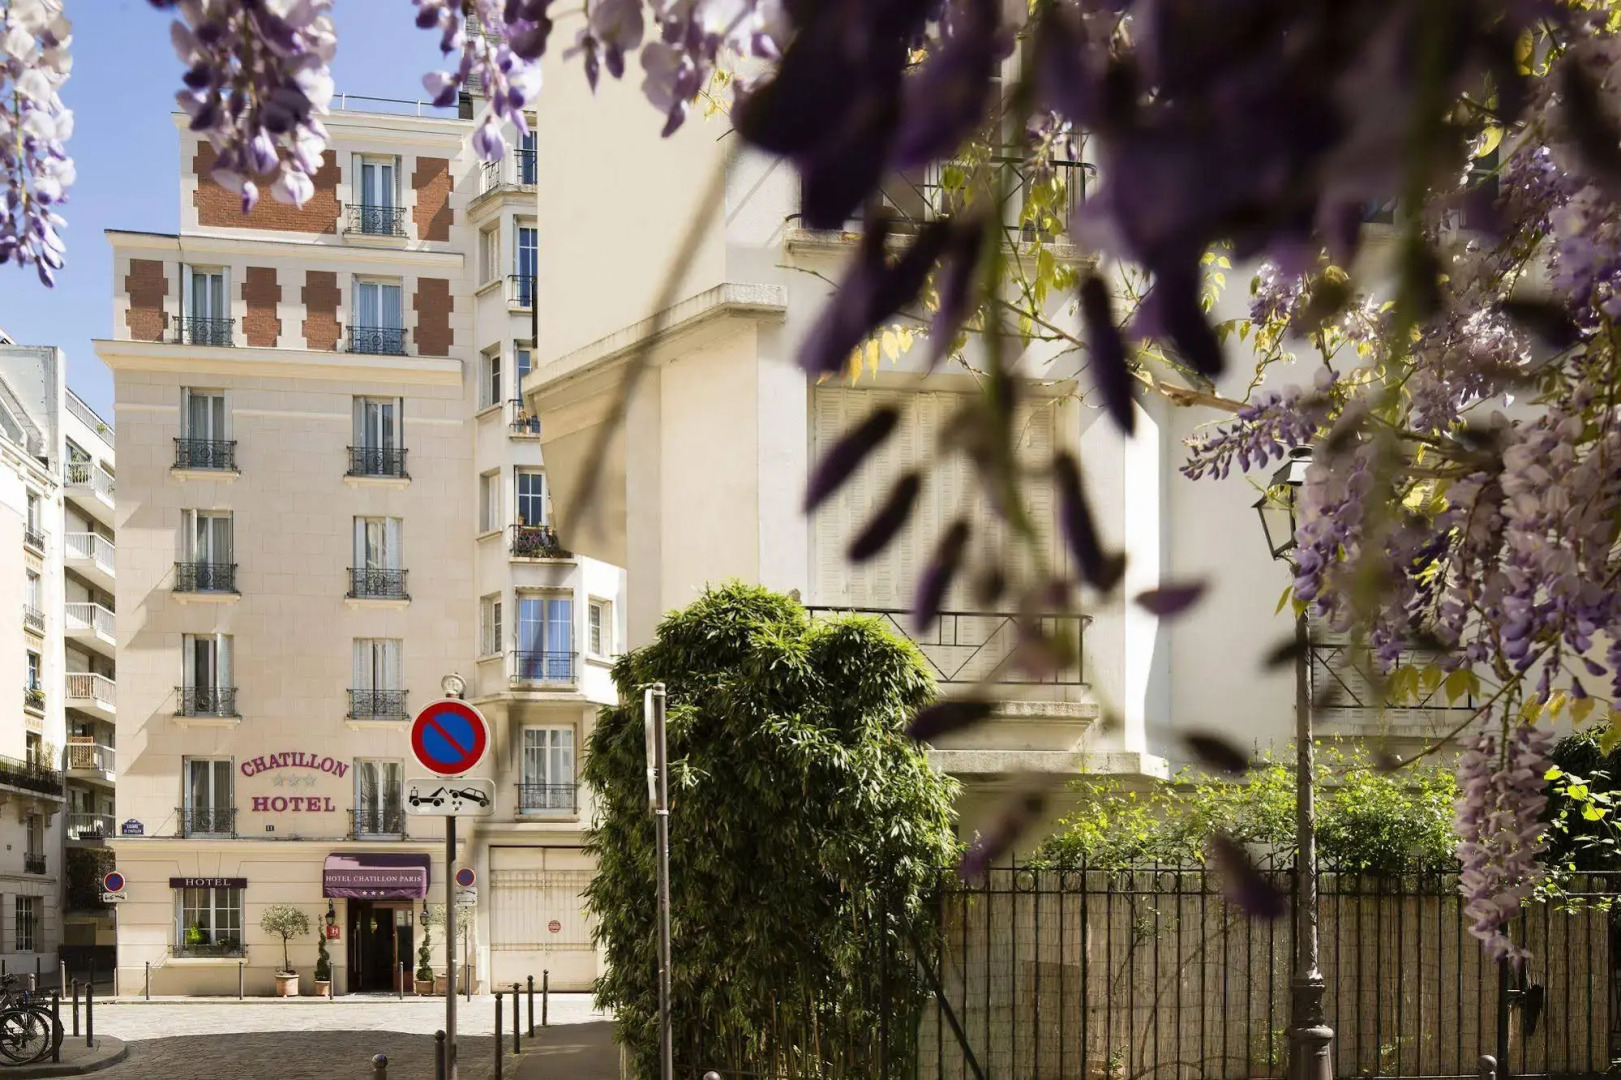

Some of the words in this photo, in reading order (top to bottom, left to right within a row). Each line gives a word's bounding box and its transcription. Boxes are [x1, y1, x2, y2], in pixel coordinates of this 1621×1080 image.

[240, 752, 350, 778] CHATILLON
[251, 796, 336, 812] HOTEL
[185, 878, 231, 886] HOTEL
